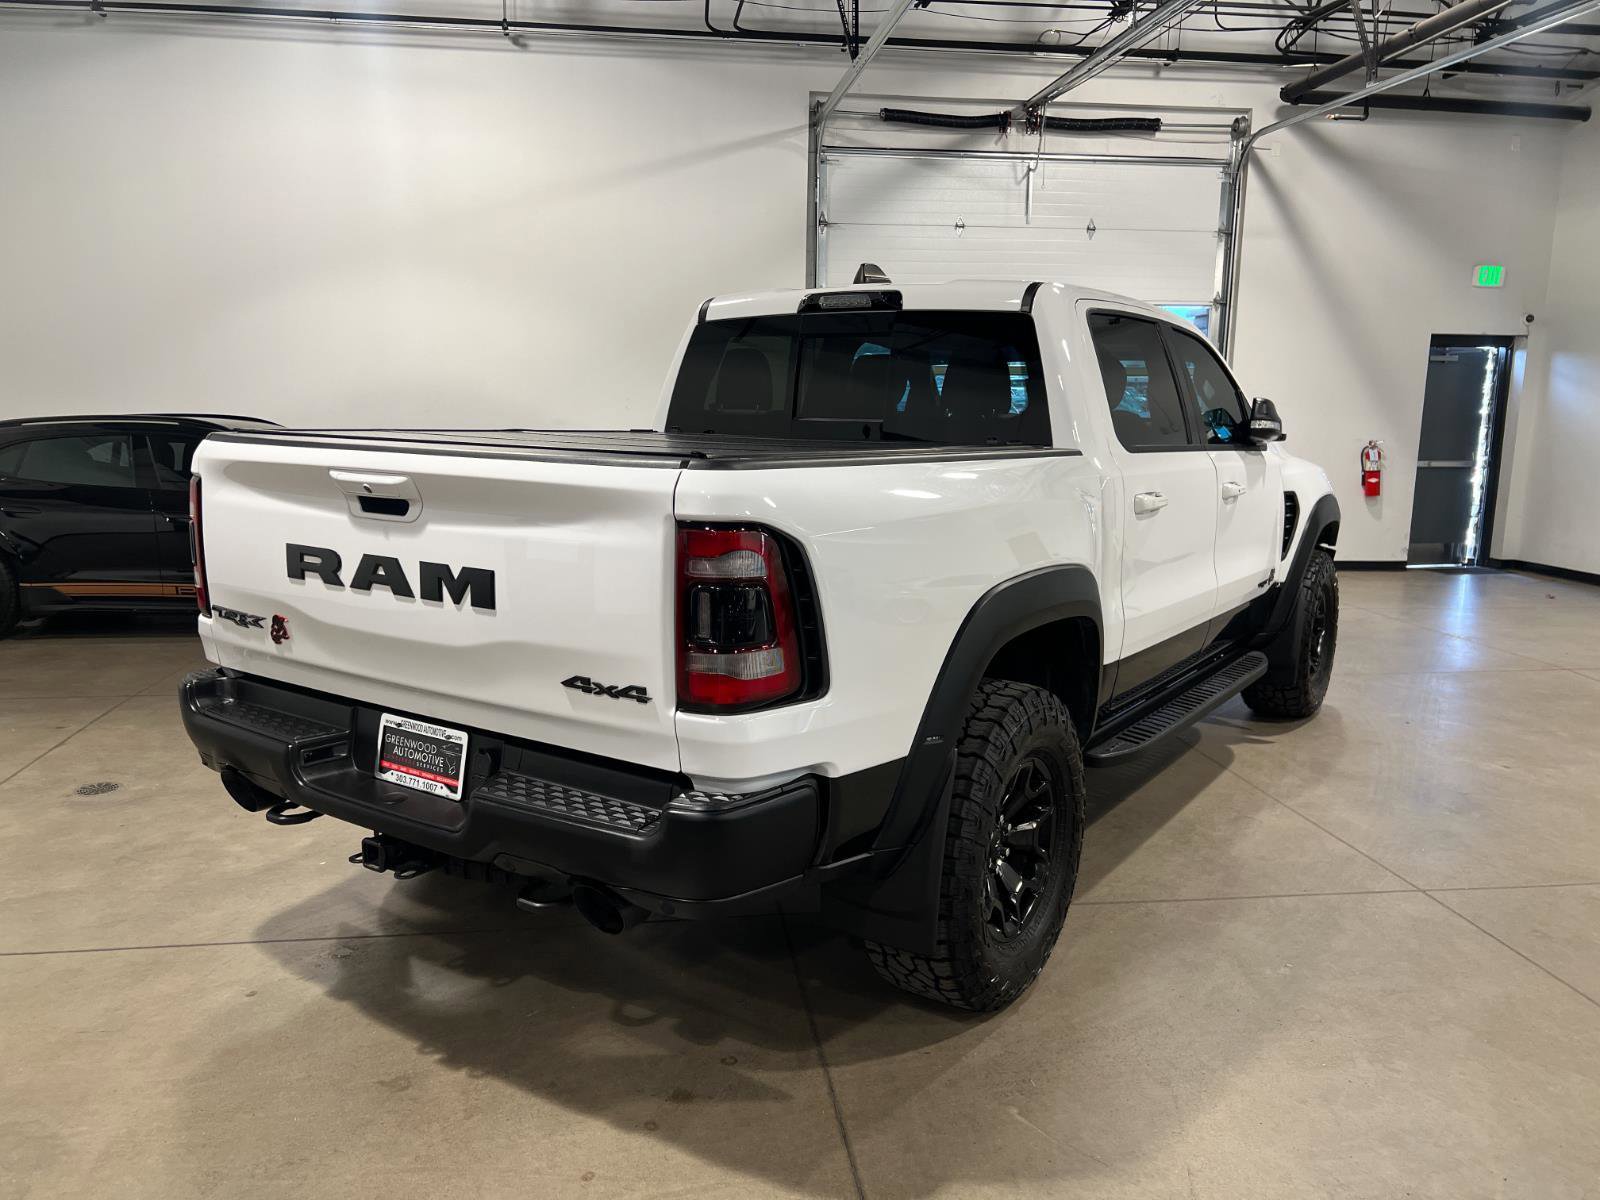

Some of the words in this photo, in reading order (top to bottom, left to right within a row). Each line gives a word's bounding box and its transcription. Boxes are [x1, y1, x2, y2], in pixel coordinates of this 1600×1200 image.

[285, 543, 497, 611] RAM
[385, 733, 437, 754] GREENWOOD
[393, 746, 444, 767] AUTOMOTIVE
